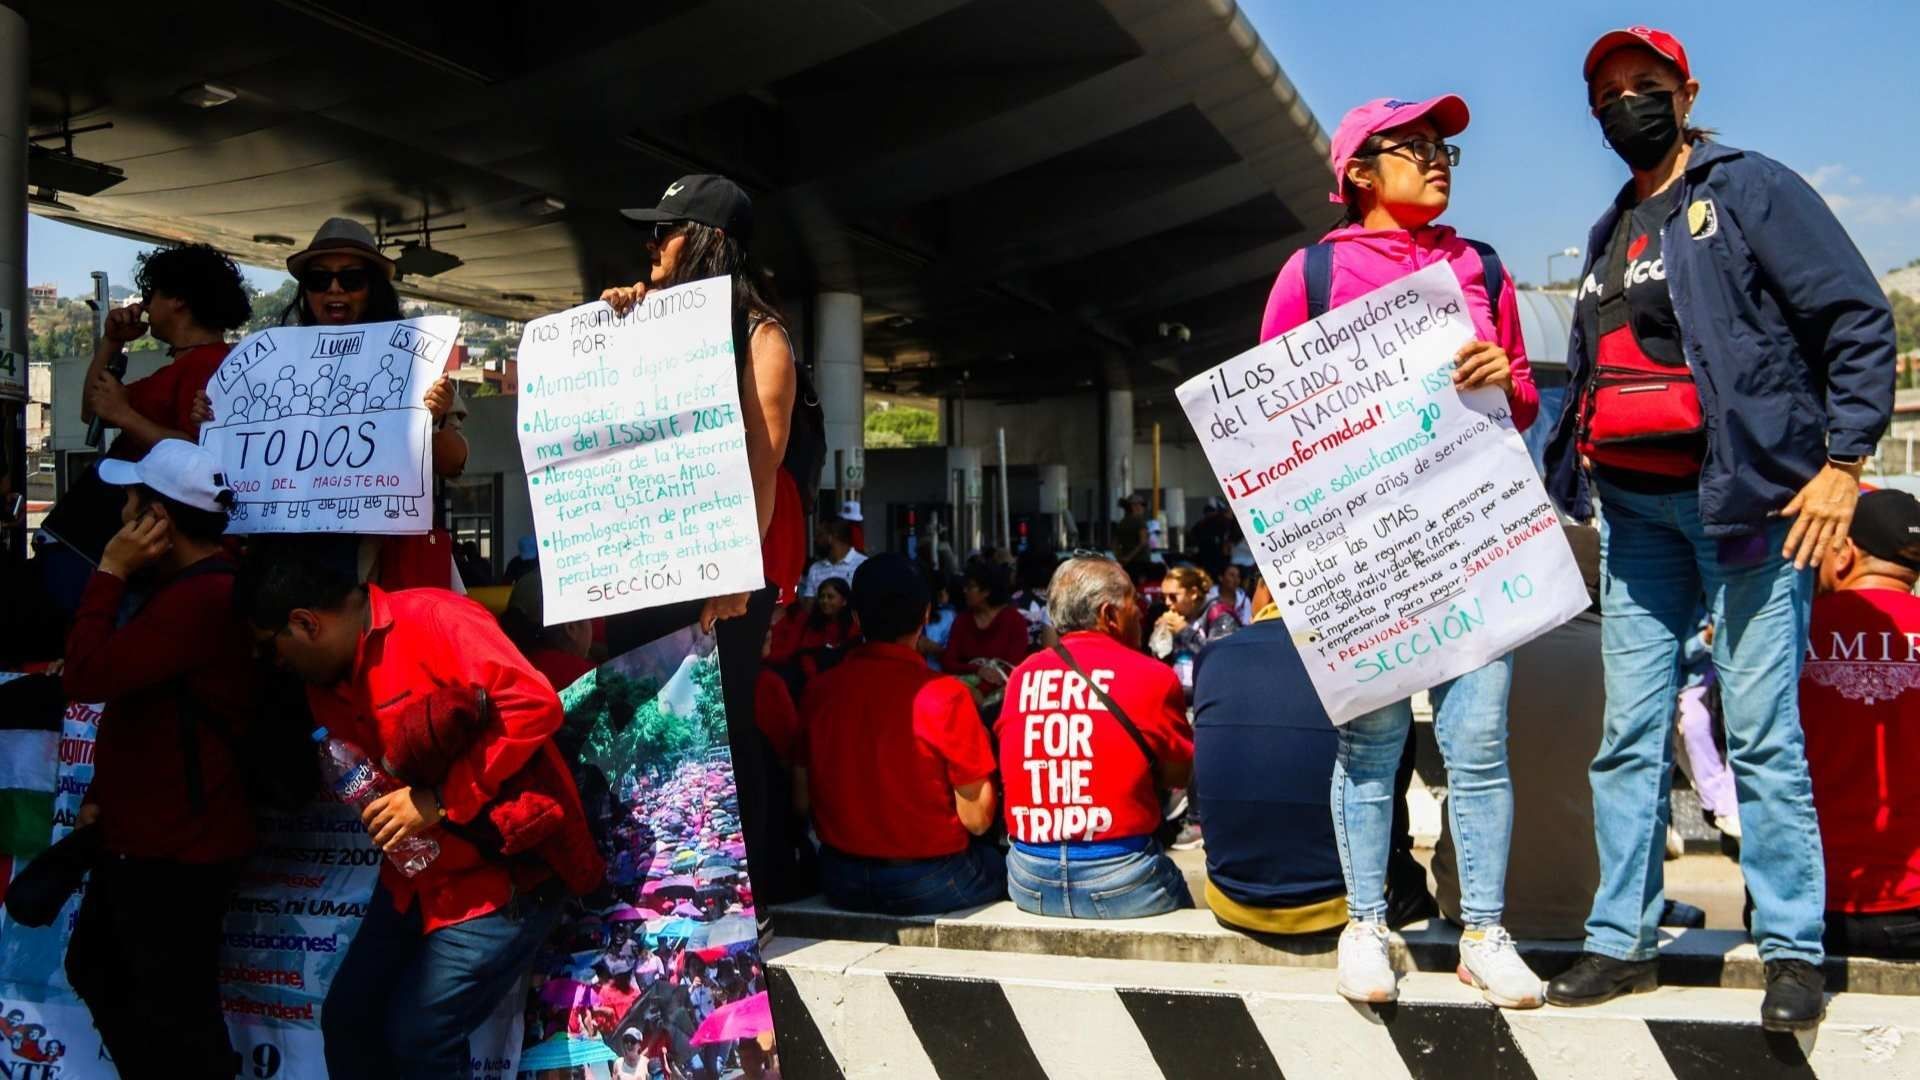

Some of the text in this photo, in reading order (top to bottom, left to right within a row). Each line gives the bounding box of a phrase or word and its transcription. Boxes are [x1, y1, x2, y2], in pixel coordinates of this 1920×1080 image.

[319, 337, 361, 355] LUCHA
[1210, 299, 1461, 441] del ESTADO a la Huelga
[534, 355, 619, 399] Aumento
[633, 353, 678, 382] digno
[1290, 359, 1409, 436] NACIONAL!
[533, 401, 625, 437] Abrogación
[634, 400, 646, 417] a
[655, 384, 669, 410] la
[537, 403, 735, 460] ma del ISSSTE 2007
[236, 421, 376, 471] TODOS
[545, 458, 622, 486] Abrogación
[629, 453, 648, 471] de
[655, 447, 669, 464] la
[232, 474, 400, 494] SOLO DEL MAGISTERIO
[556, 481, 697, 522] fuera USICAMM
[1266, 507, 1342, 553] Jubilación
[1346, 492, 1368, 517] por
[1376, 472, 1409, 495] años
[1415, 458, 1430, 475] de
[1435, 420, 1489, 462] servicio,
[1294, 488, 1326, 515] que
[552, 514, 650, 552] Homologación
[658, 508, 676, 524] de
[557, 516, 733, 569] ones respecto a las que
[1272, 522, 1346, 575] por edad
[1288, 504, 1419, 587] Quitar las UMAS
[1295, 572, 1346, 604] Cambio
[1354, 560, 1368, 574] de
[1425, 519, 1438, 532] de
[1441, 481, 1495, 523] pensiones
[559, 531, 753, 596] perciben otras entidades
[697, 562, 720, 582] 10
[1305, 588, 1352, 616] cuentas
[1357, 549, 1424, 589] individuales
[1426, 511, 1475, 550] (AFORES)
[1481, 500, 1497, 519] por
[1315, 502, 1551, 642] Impuestos progresivos a grandes banqueros
[1309, 611, 1330, 626] ma
[1335, 582, 1387, 614] solidario
[1393, 568, 1410, 582] de
[1502, 574, 1534, 604] 10
[1327, 612, 1390, 650] empresarios
[1398, 598, 1424, 618] para
[1019, 668, 1115, 713] HERE
[1024, 713, 1094, 758] FOR
[1023, 759, 1093, 804] THE
[1011, 806, 1113, 844] TRIPP
